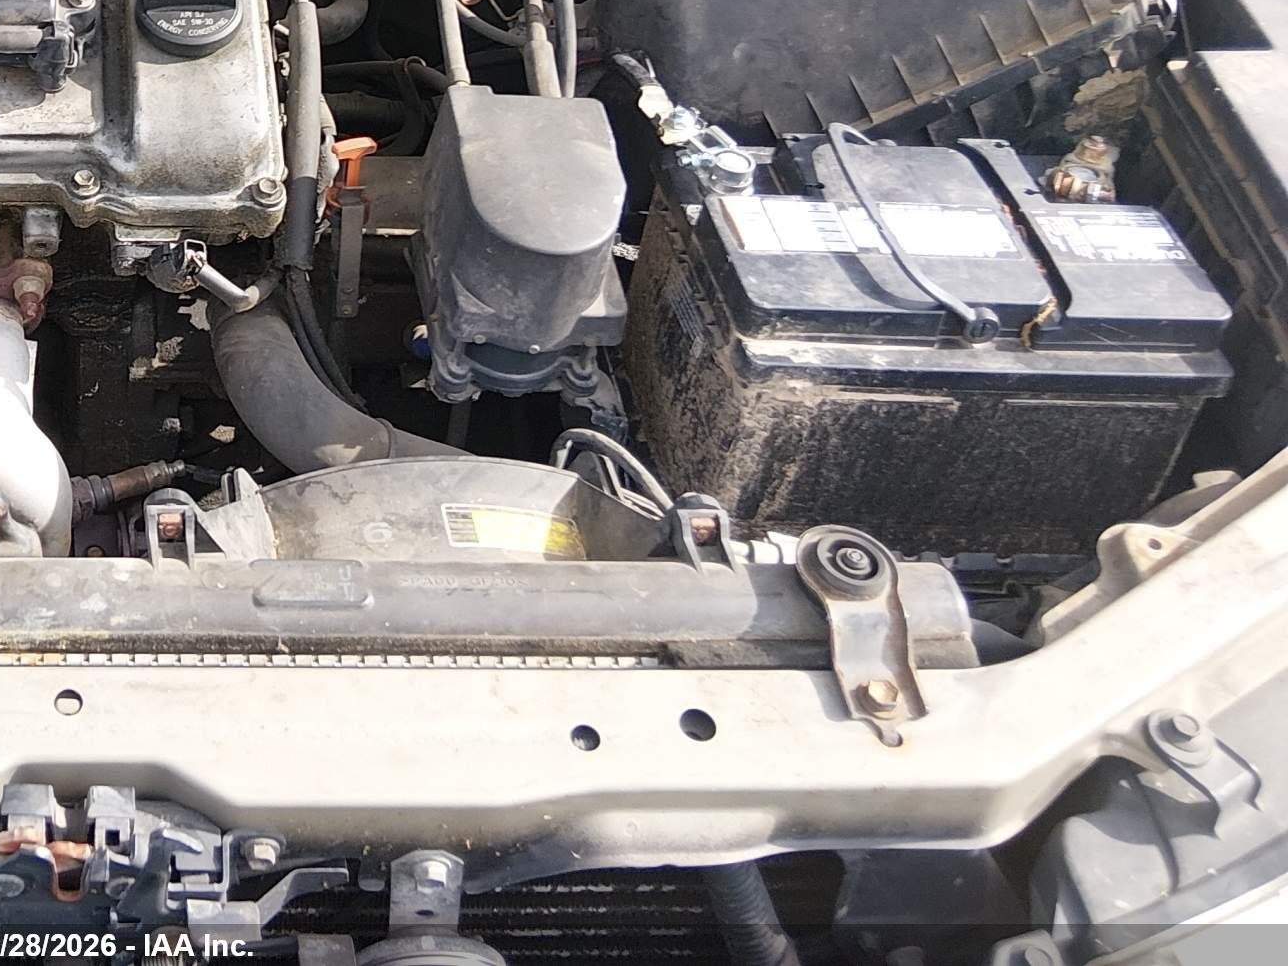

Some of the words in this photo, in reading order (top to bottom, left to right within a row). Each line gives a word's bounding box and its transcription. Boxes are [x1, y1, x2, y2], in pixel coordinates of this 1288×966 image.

[179, 11, 192, 19] API
[190, 18, 214, 26] 5W-30
[156, 19, 184, 34] ENERGY
[188, 17, 229, 36] CONSERVING
